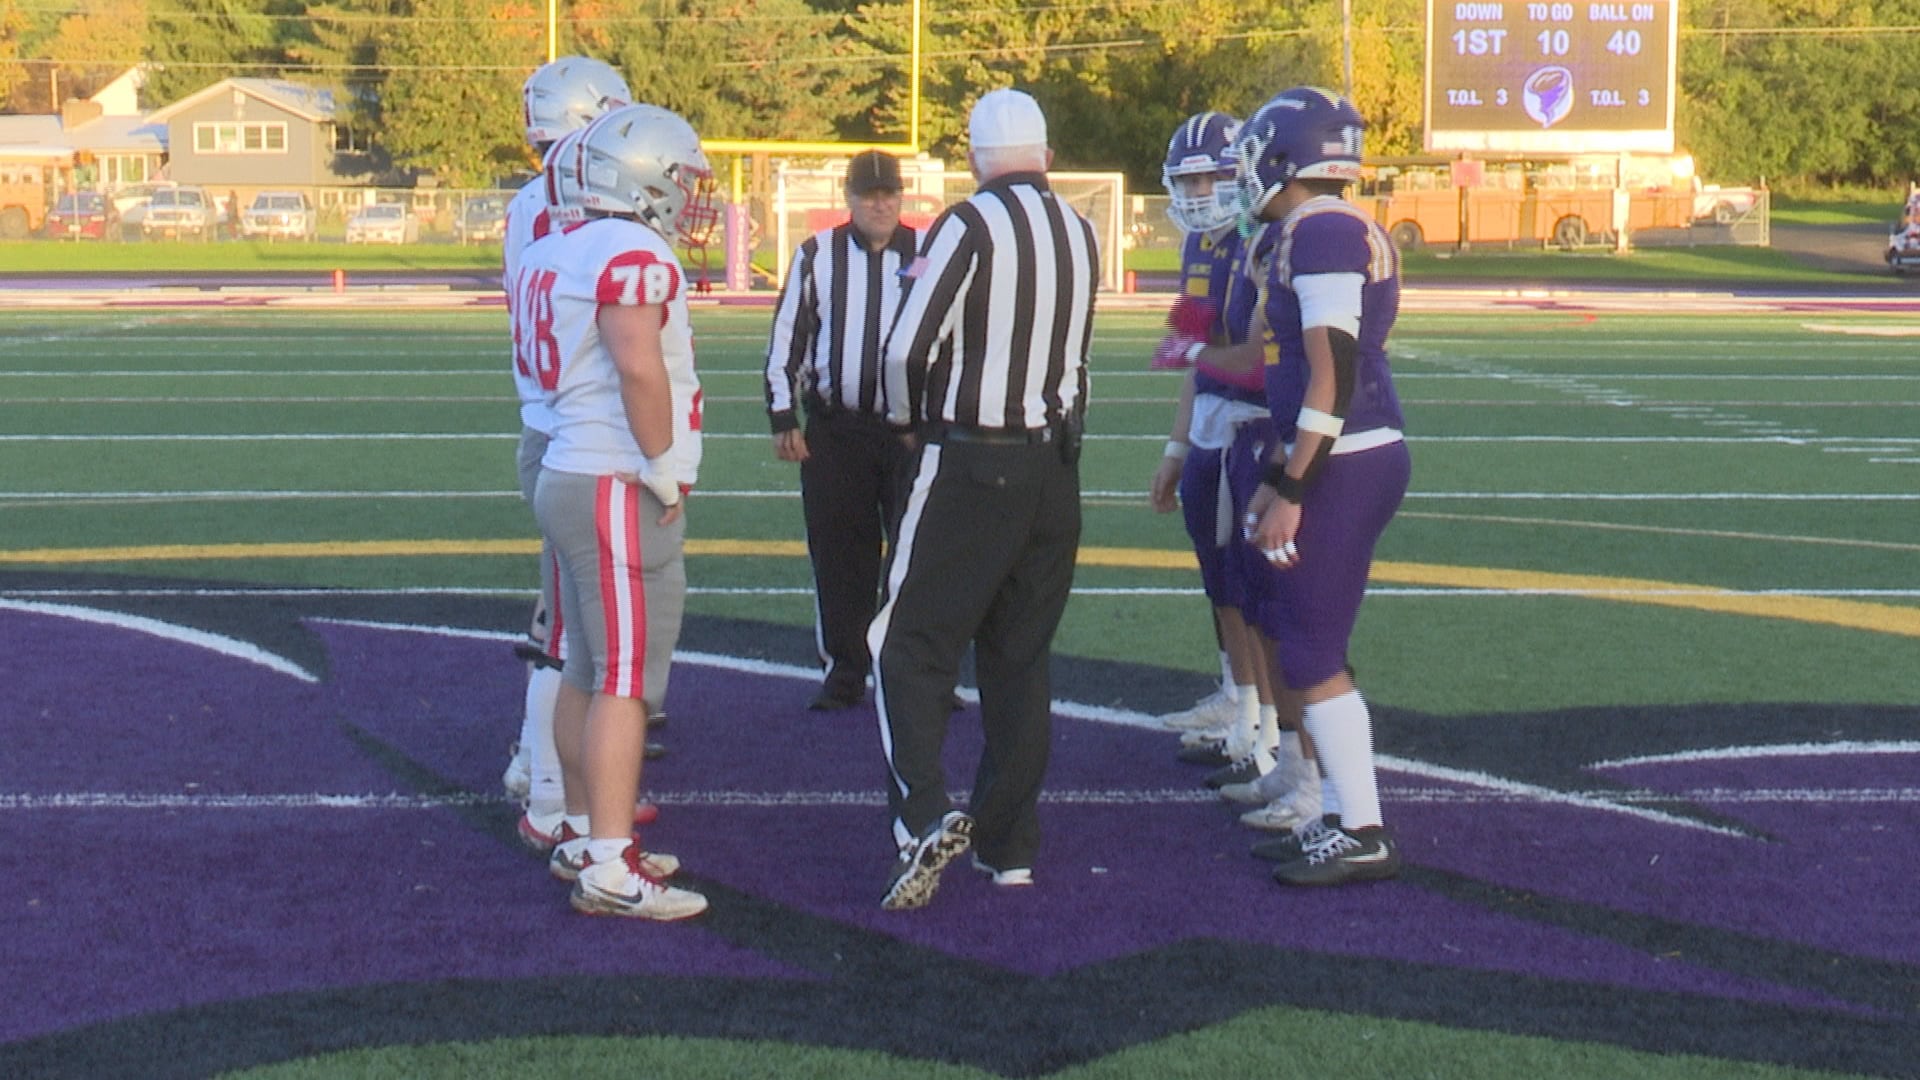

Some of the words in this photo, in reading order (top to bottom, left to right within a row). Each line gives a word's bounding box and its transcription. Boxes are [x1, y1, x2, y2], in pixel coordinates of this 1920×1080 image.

[1455, 3, 1503, 21] DOWN
[1527, 3, 1548, 21] TO
[1550, 3, 1573, 21] GO
[1588, 3, 1628, 21] BALL
[1631, 3, 1654, 21] ON
[1452, 29, 1508, 55] 1ST
[1537, 29, 1570, 55] 10
[1606, 29, 1641, 55] 40
[1447, 89, 1483, 105] T.O.L.
[1496, 89, 1508, 105] 3
[1590, 90, 1626, 106] T.O.L.
[1638, 90, 1650, 106] 3
[610, 263, 671, 306] 78
